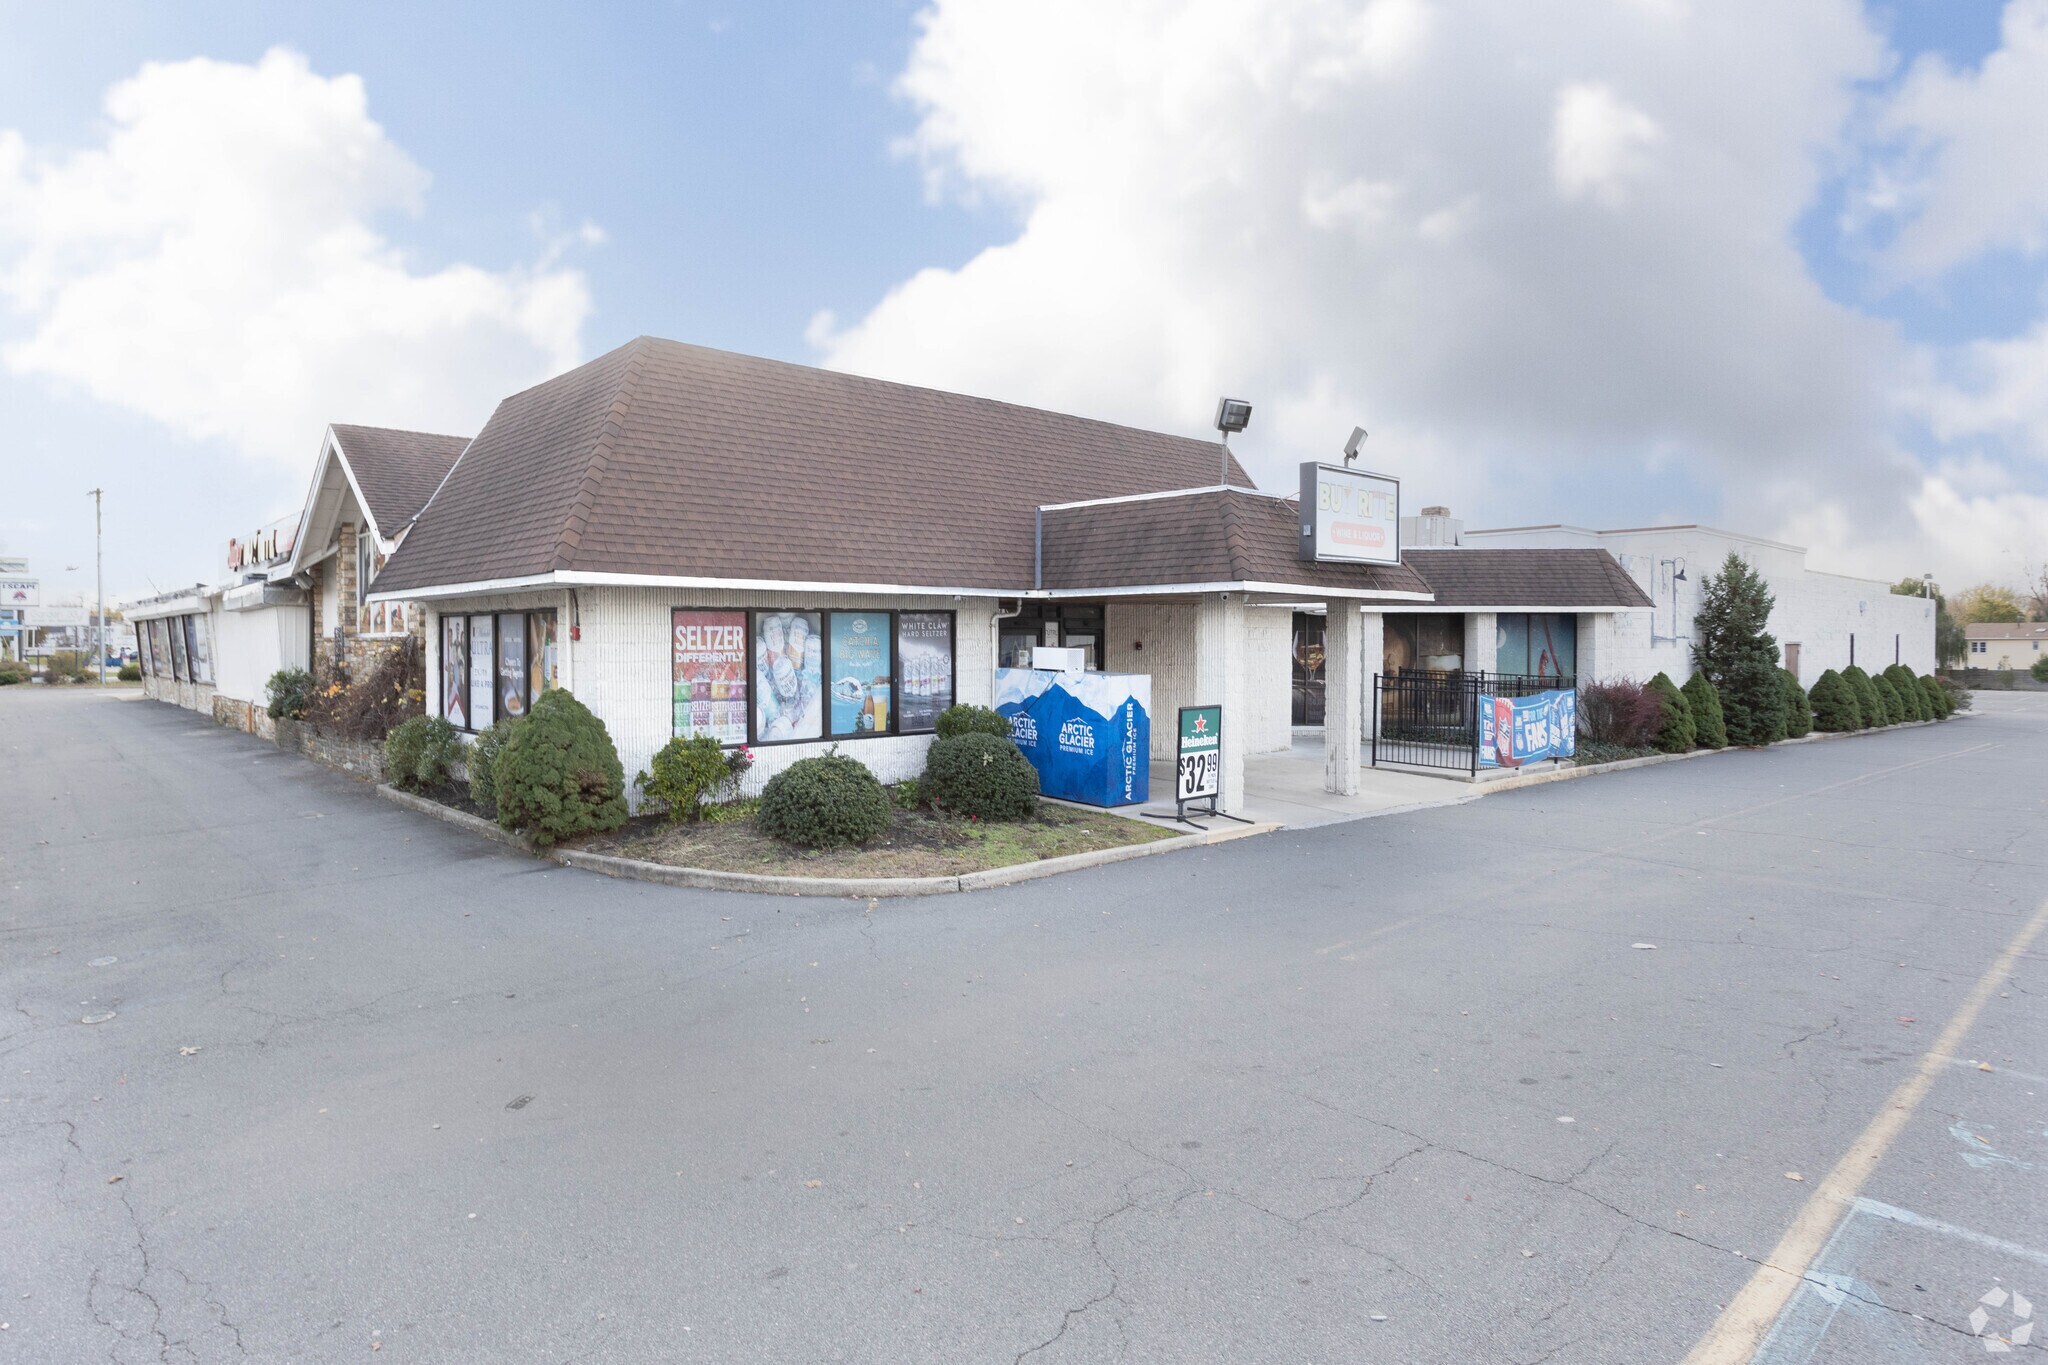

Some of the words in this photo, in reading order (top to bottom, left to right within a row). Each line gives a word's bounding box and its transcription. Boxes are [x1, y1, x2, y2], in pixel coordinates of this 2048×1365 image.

[1357, 489, 1395, 521] RITE
[901, 622, 926, 630] WHITE
[928, 620, 948, 630] CLAW
[675, 625, 744, 650] SELTZER
[471, 640, 492, 656] ULTRA
[675, 651, 744, 663] DIFFERENTLY
[1007, 728, 1038, 740] LACIER
[1061, 722, 1093, 737] ARCTIC
[1525, 718, 1548, 752] FANS
[1028, 740, 1037, 748] ICE
[1059, 733, 1095, 749] GLACIER
[1181, 733, 1218, 749] Heineken
[1060, 745, 1083, 755] PREMIUM
[1084, 748, 1094, 756] ICE
[1125, 757, 1133, 800] ARCTIC
